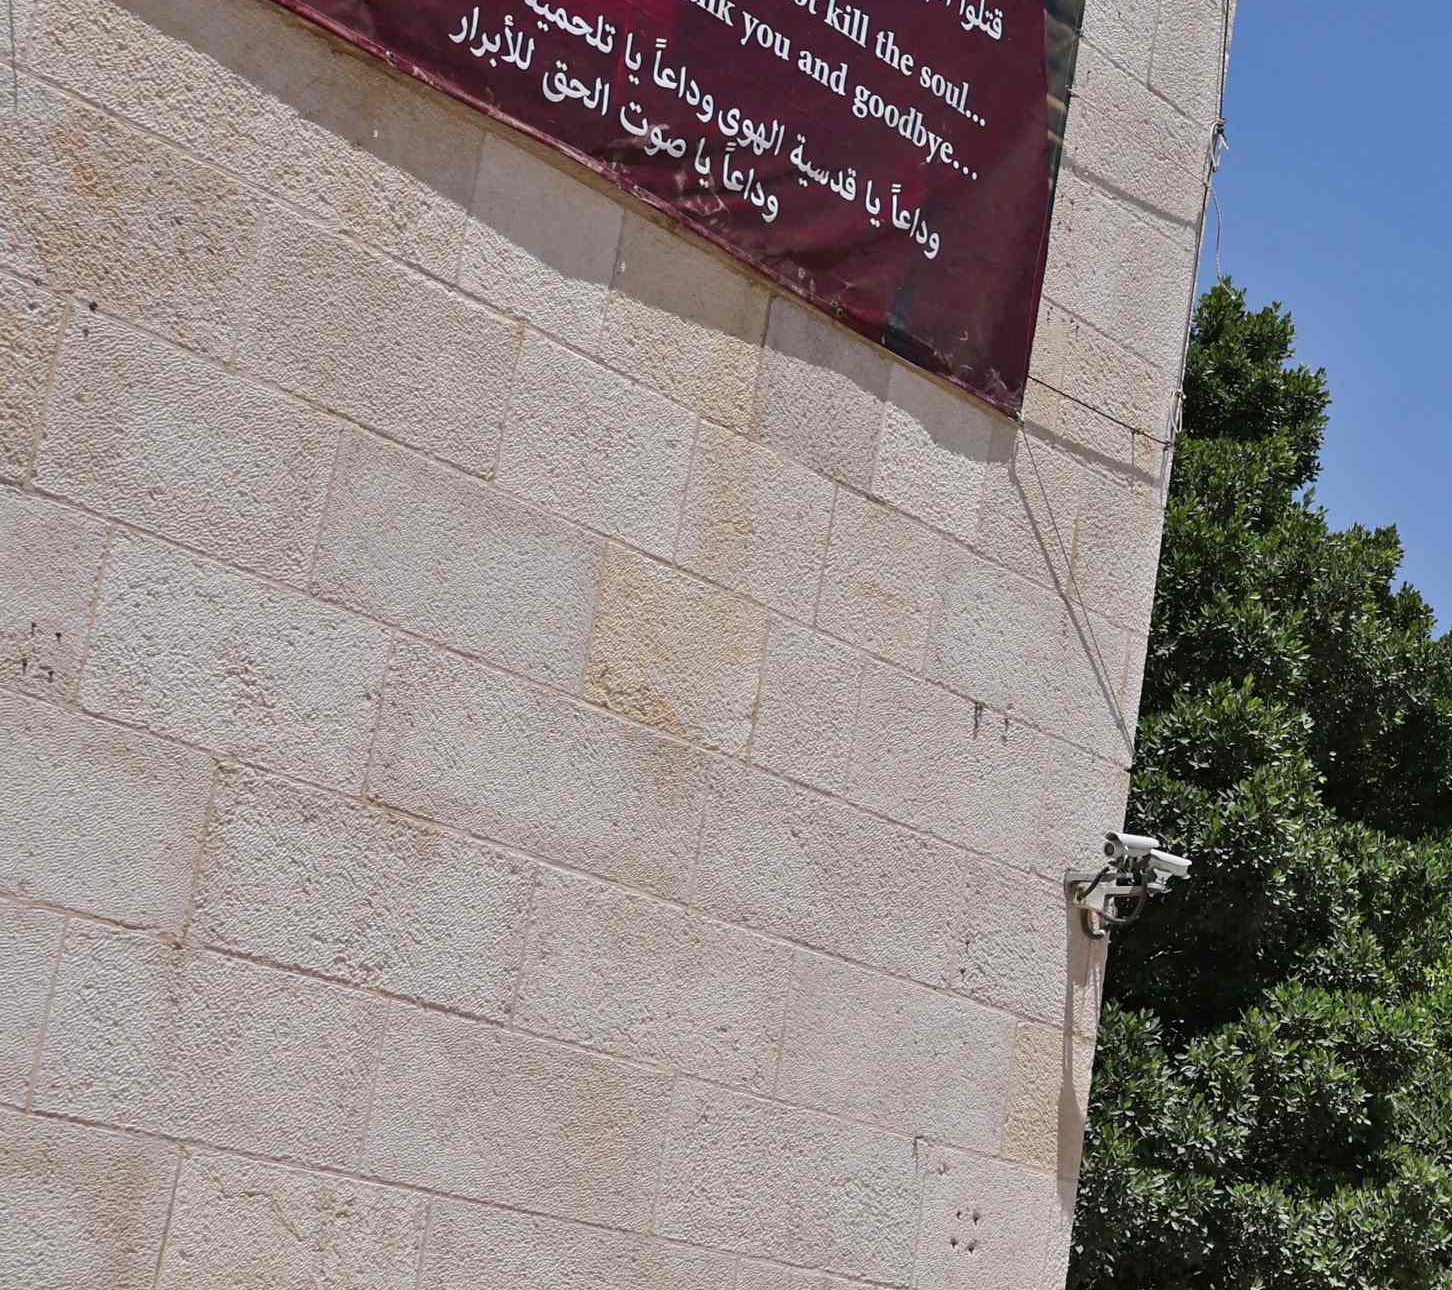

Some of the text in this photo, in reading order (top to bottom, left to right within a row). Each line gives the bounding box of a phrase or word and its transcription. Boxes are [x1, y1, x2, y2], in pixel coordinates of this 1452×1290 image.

[449, 7, 534, 69] للأبرار
[625, 33, 641, 85] يا
[543, 61, 609, 115] الحق
[741, 12, 790, 60] you
[798, 51, 847, 95] and
[853, 86, 977, 179] goodbye...
[876, 32, 913, 75] the
[920, 67, 985, 126] soul...
[620, 102, 686, 157] صوت
[718, 108, 784, 155] الهوى
[695, 138, 710, 187] يا
[790, 134, 856, 200] قدسية
[866, 181, 880, 227] يا
